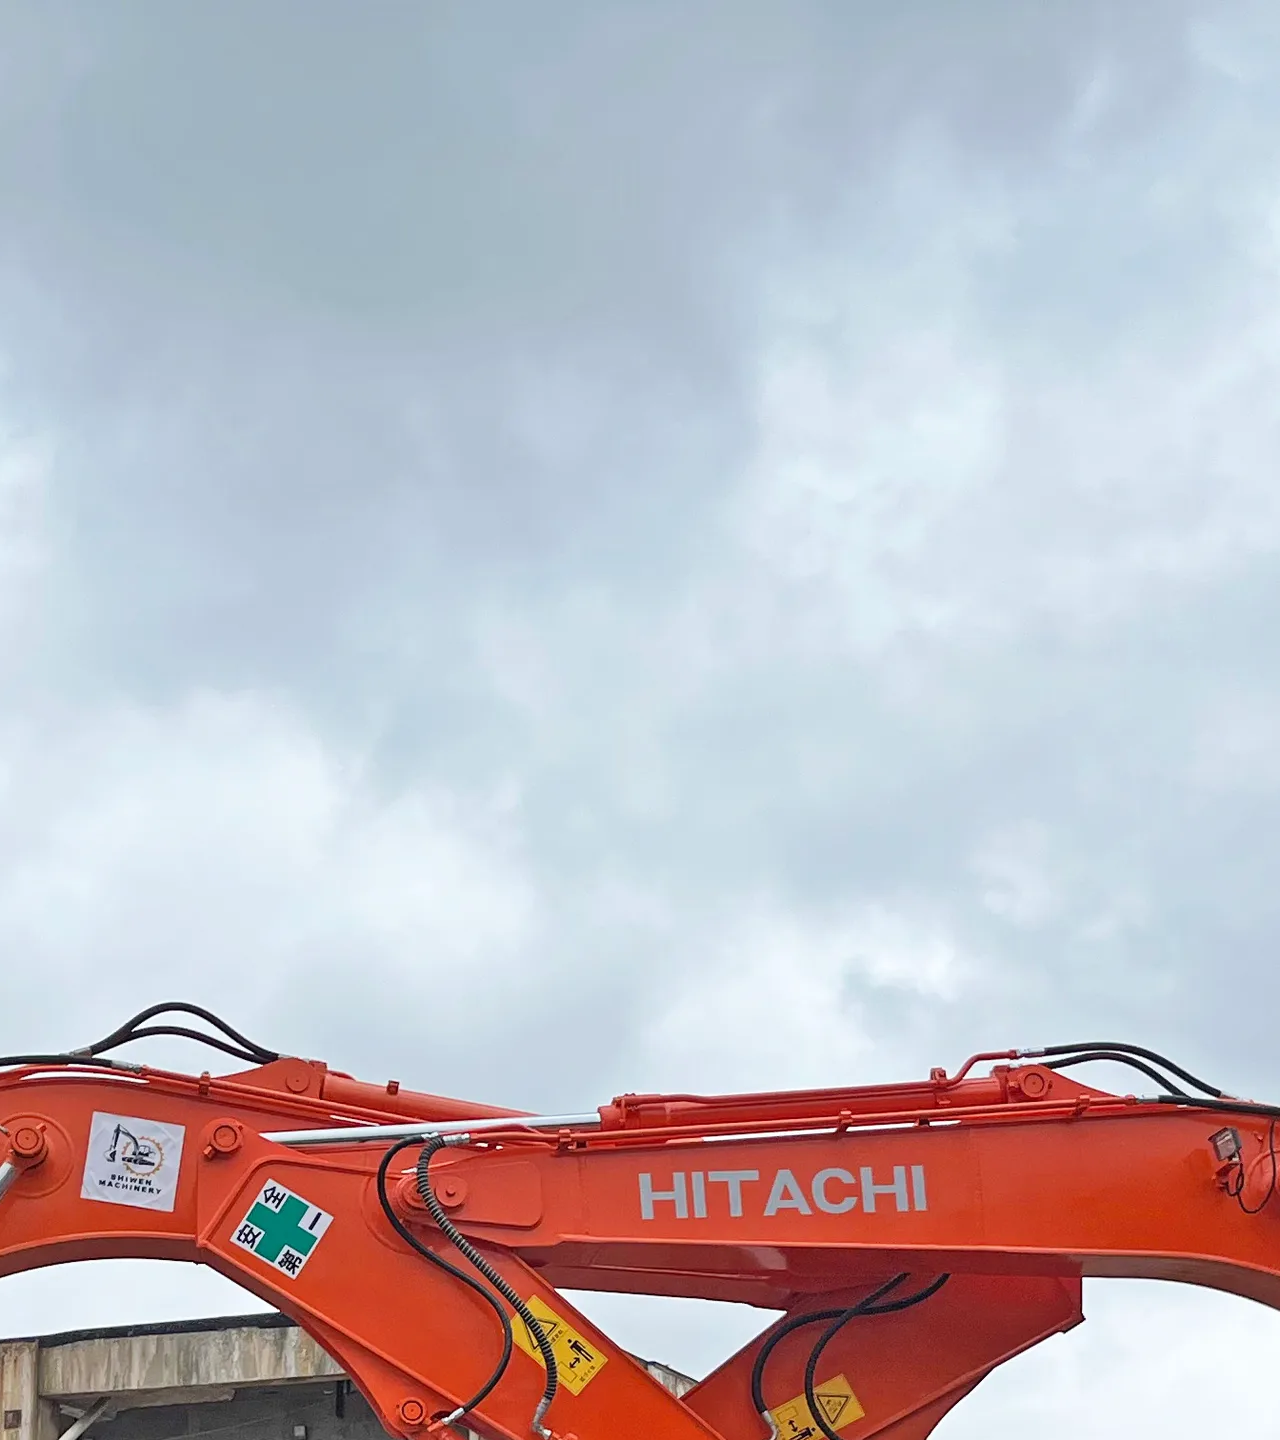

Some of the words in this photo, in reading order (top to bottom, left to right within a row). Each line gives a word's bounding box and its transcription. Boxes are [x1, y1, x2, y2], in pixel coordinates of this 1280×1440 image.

[98, 1179, 162, 1194] MACHINERY
[110, 1173, 152, 1186] SHIWEN
[638, 1165, 928, 1220] HITACHI
